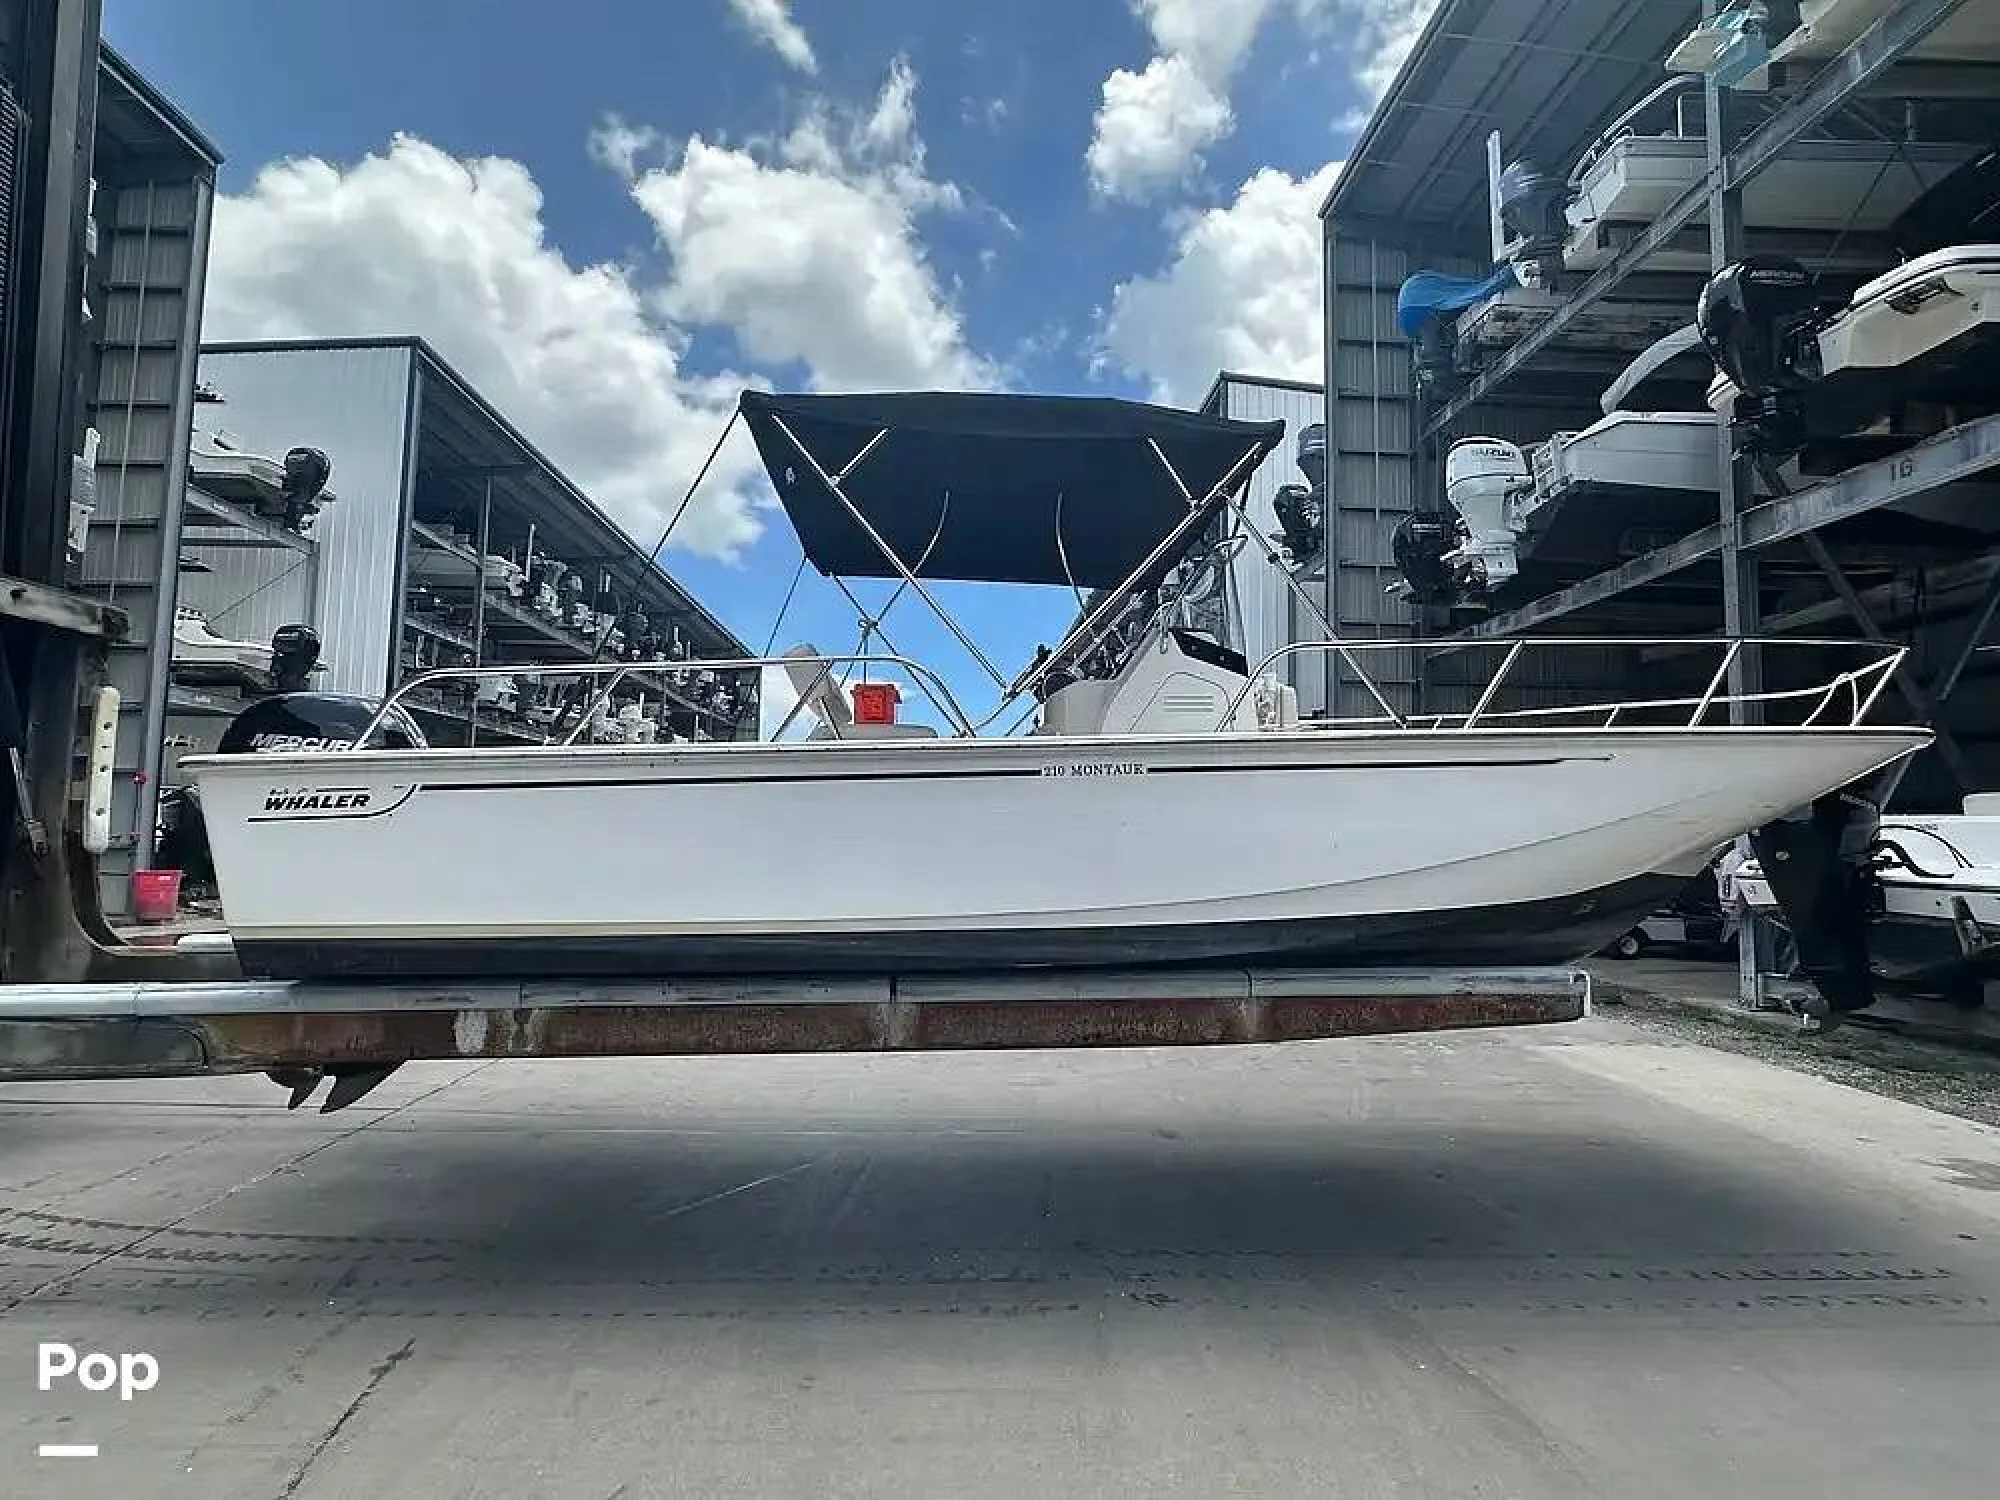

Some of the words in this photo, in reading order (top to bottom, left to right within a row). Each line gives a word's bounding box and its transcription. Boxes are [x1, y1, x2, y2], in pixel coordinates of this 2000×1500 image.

[250, 733, 364, 751] MERCUR
[1042, 765, 1065, 777] 210
[1071, 763, 1145, 777] MONTAUK
[264, 795, 371, 811] WHALER
